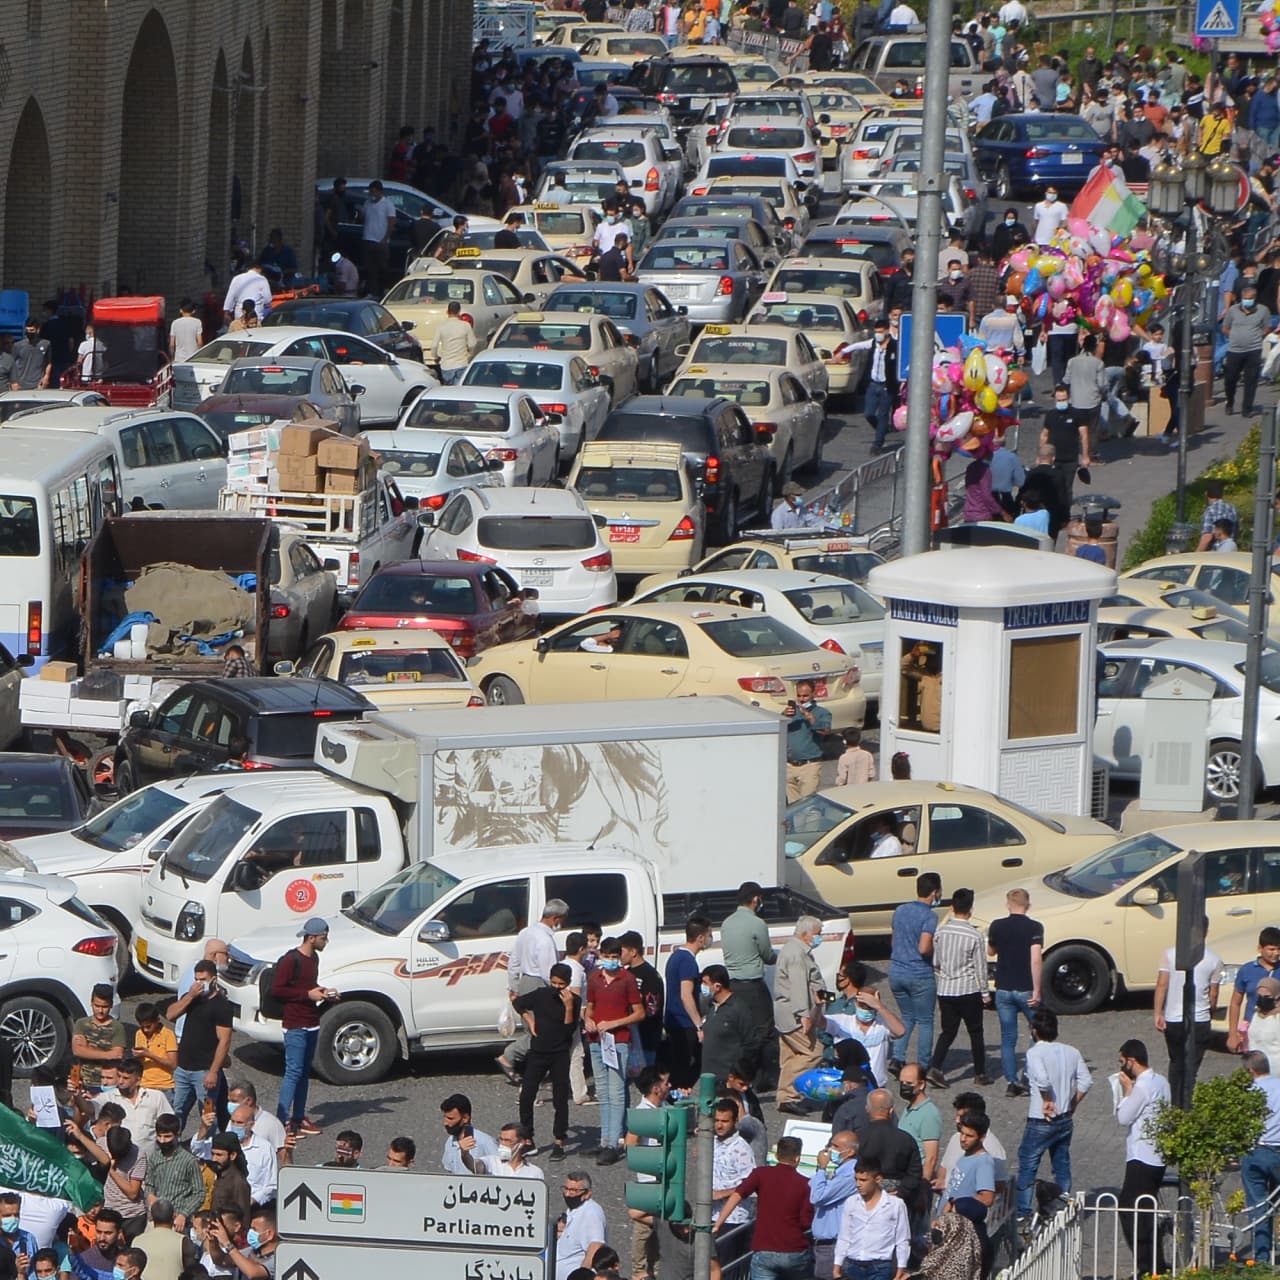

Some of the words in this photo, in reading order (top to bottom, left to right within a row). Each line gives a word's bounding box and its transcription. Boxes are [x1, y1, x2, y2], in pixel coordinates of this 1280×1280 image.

[1007, 604, 1048, 628] TRAFFIC
[1050, 599, 1088, 622] POLICE
[442, 1182, 536, 1219] پەرلەمان
[422, 1216, 536, 1239] Parliament
